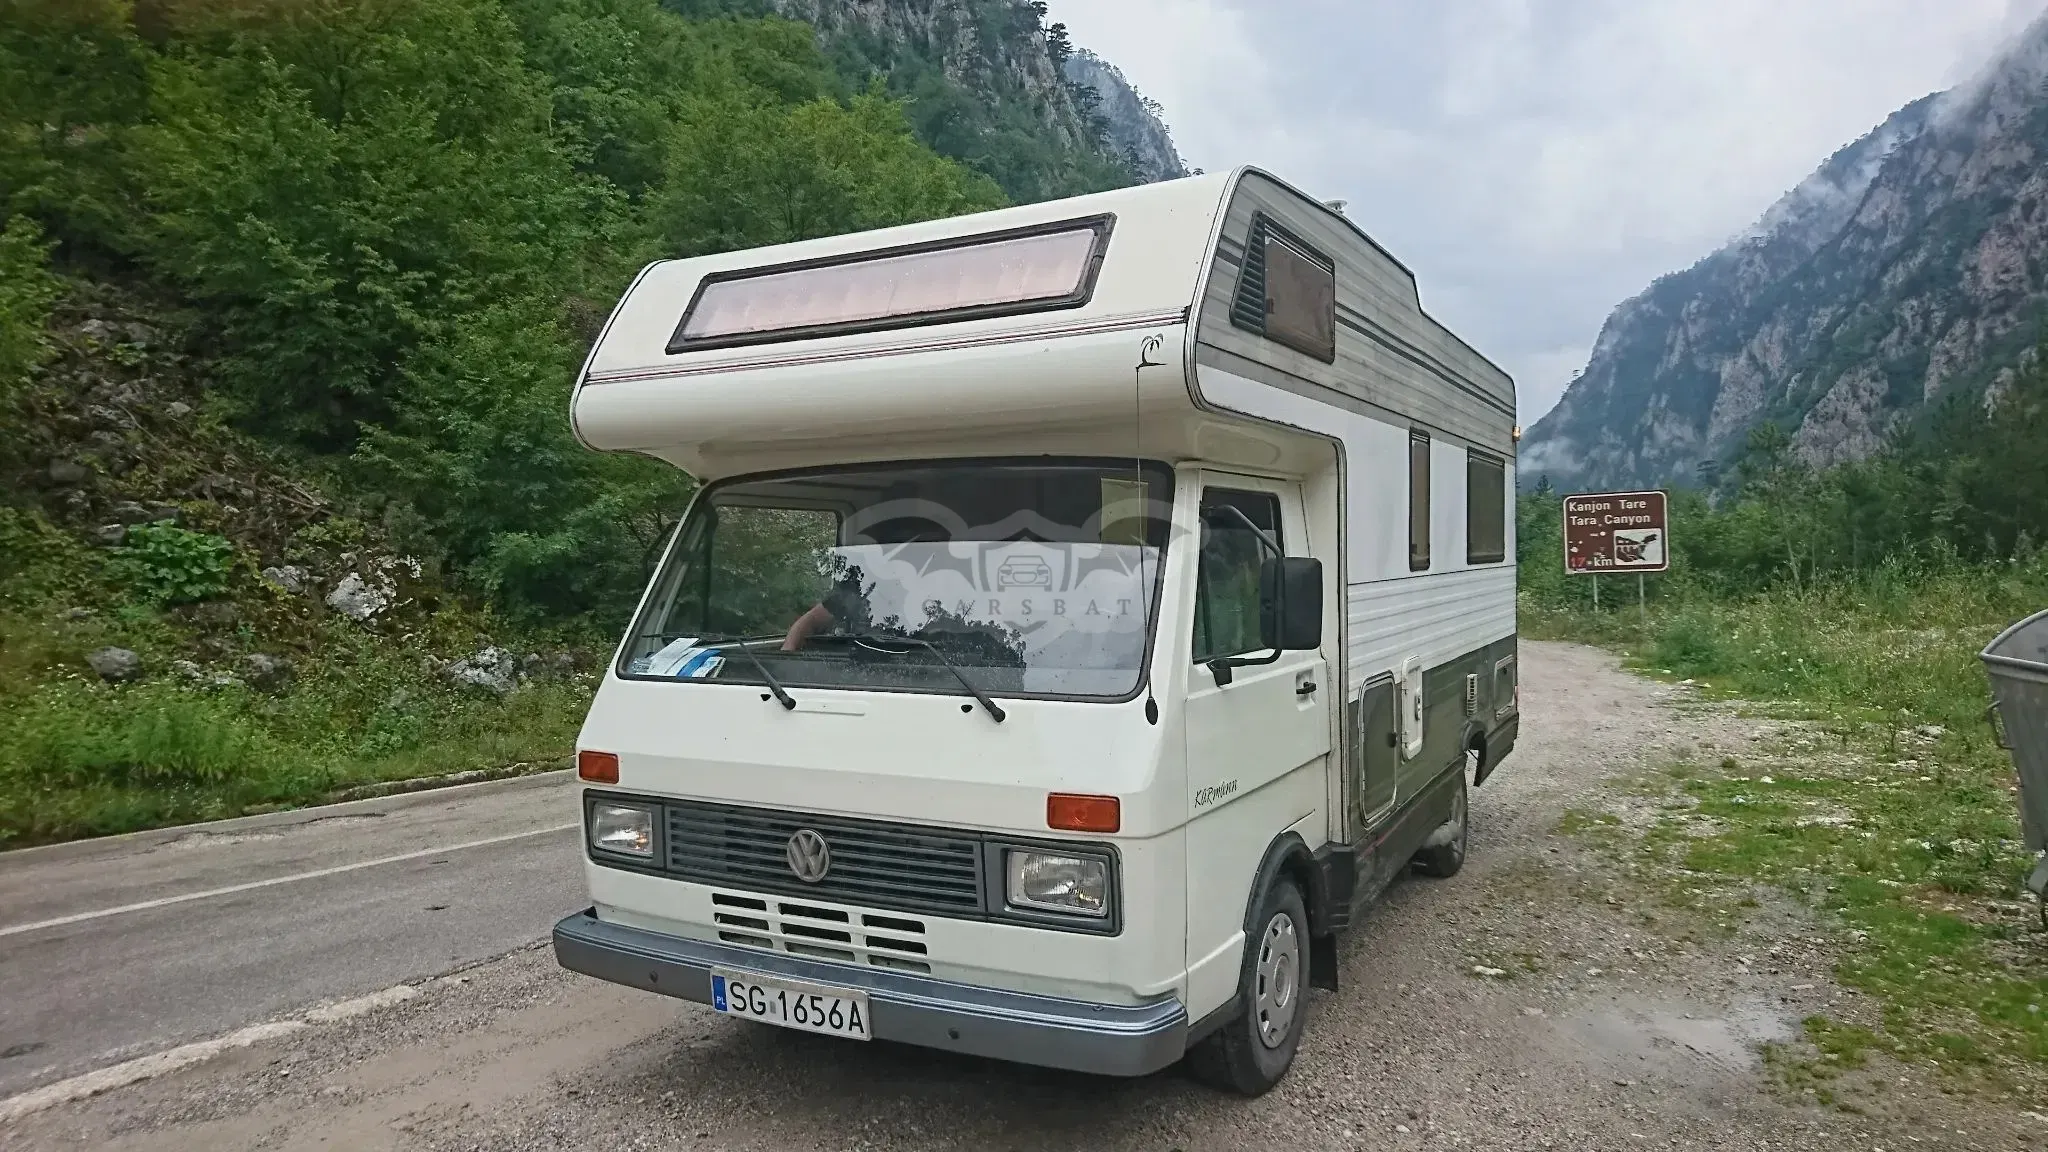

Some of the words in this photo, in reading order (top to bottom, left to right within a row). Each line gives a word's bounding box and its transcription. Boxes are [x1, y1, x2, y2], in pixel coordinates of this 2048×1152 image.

[1569, 501, 1611, 513] Kanjon
[1619, 499, 1647, 510] Tare
[1570, 516, 1597, 526] Tara
[1604, 514, 1651, 526] Canyon
[1593, 556, 1613, 567] km
[716, 996, 727, 1006] PL
[729, 981, 767, 1016] SG
[777, 990, 865, 1034] 1656A
